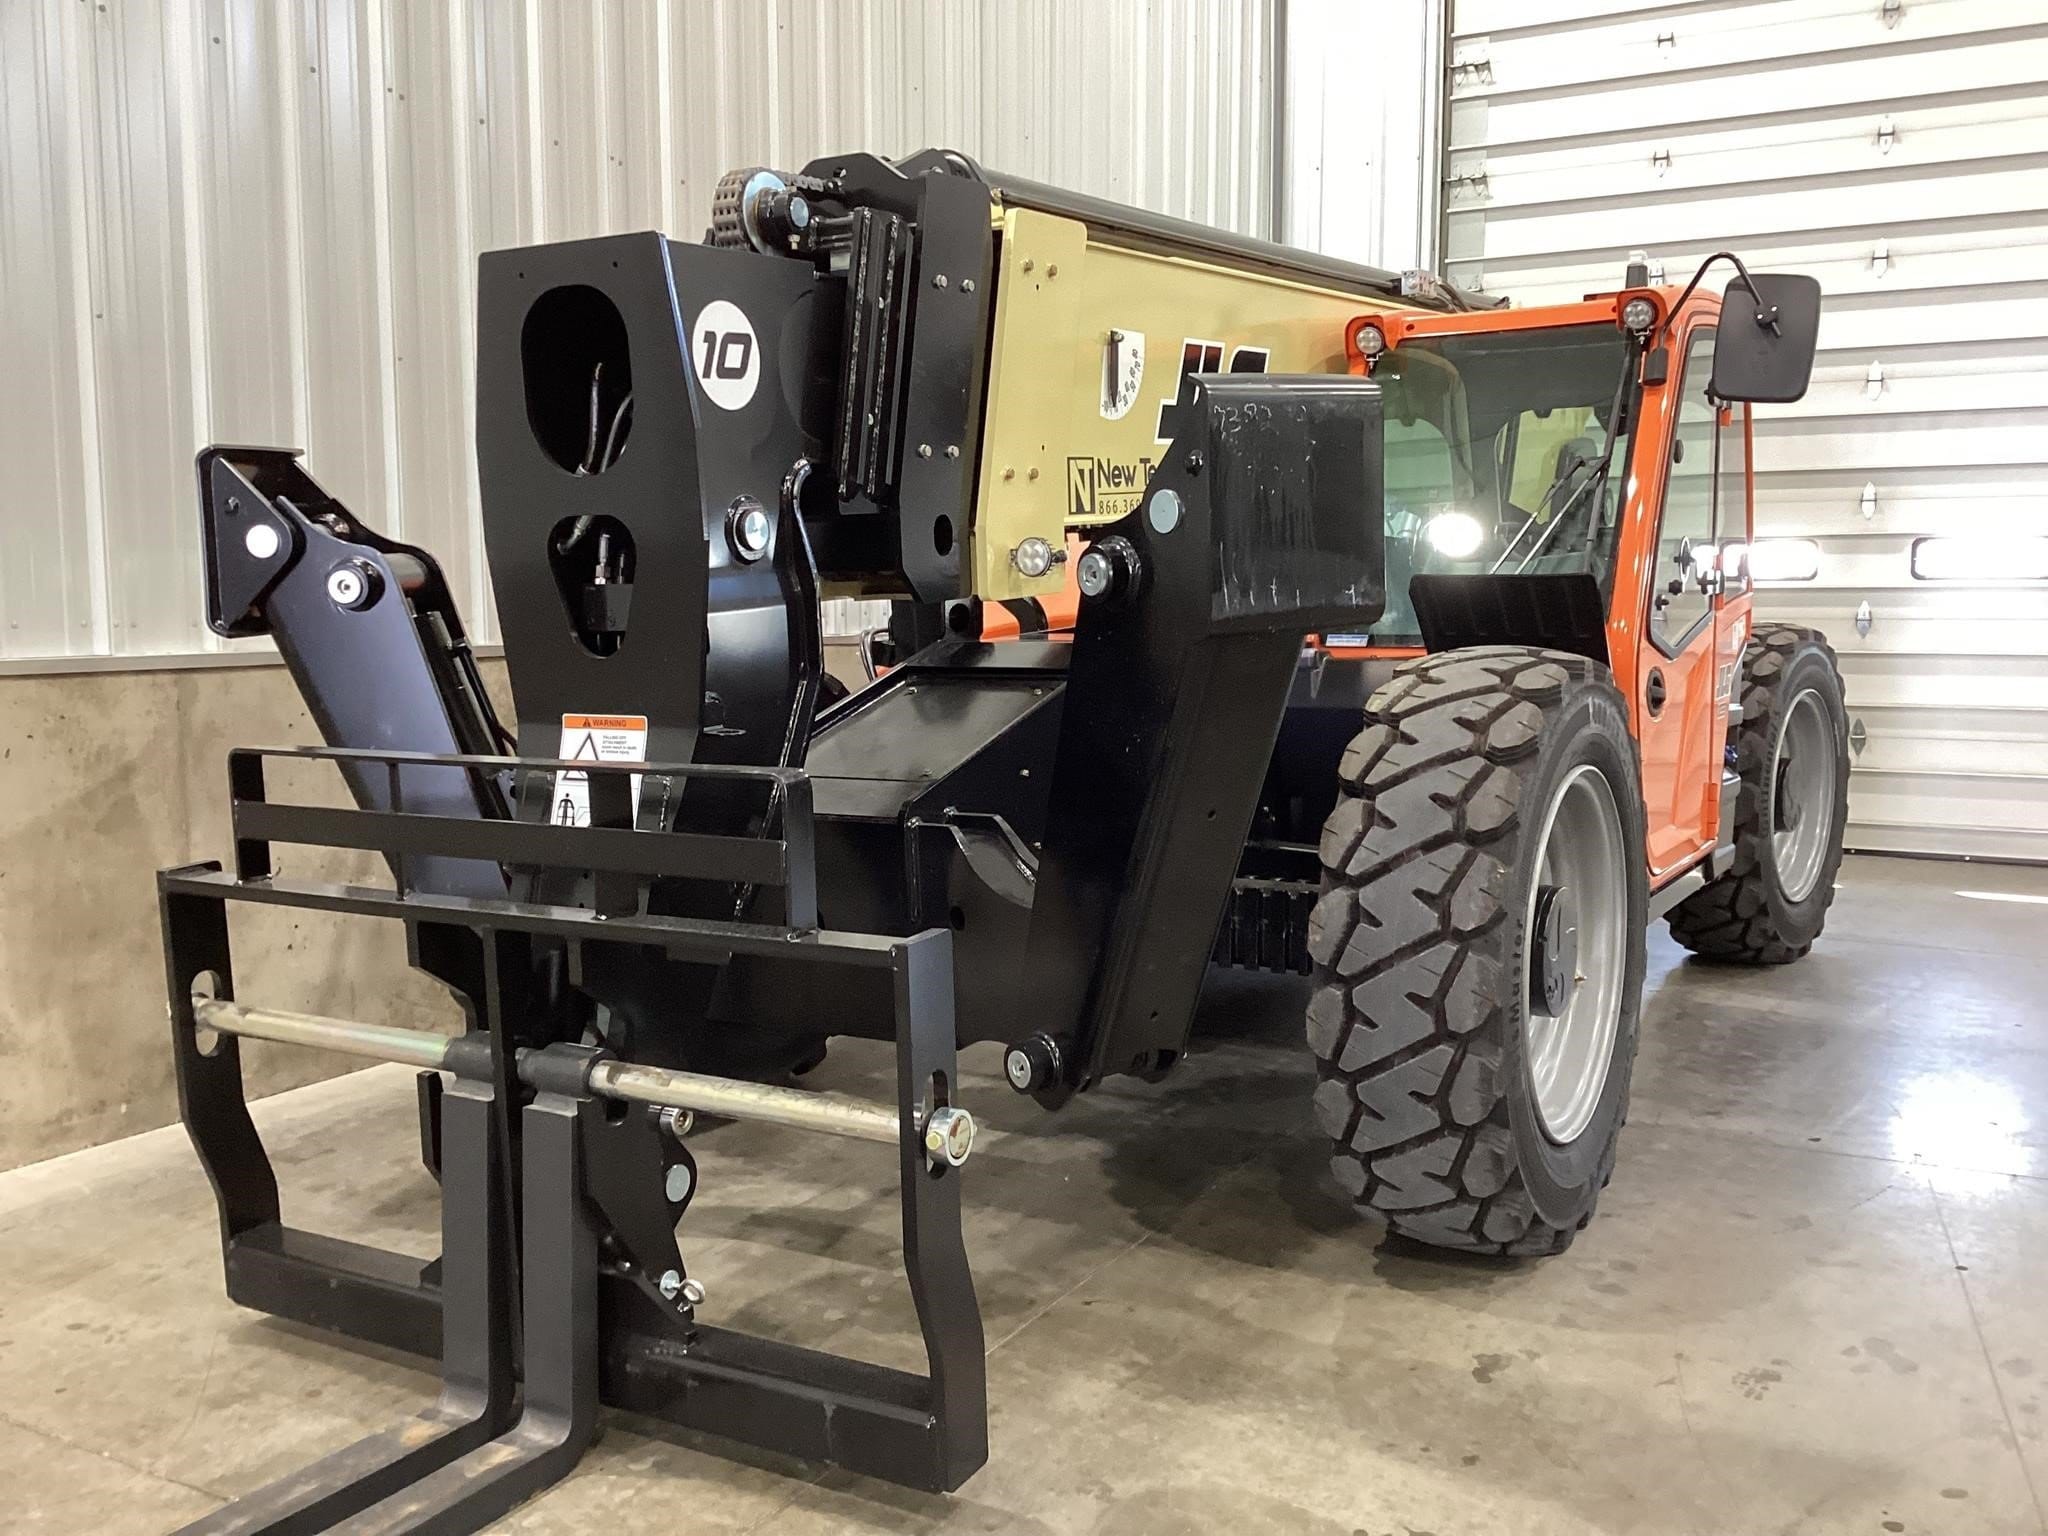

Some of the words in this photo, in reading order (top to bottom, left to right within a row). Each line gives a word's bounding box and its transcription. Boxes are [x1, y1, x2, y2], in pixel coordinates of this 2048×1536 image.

[702, 330, 752, 379] 10
[1097, 458, 1137, 488] New
[593, 719, 627, 728] WARNING
